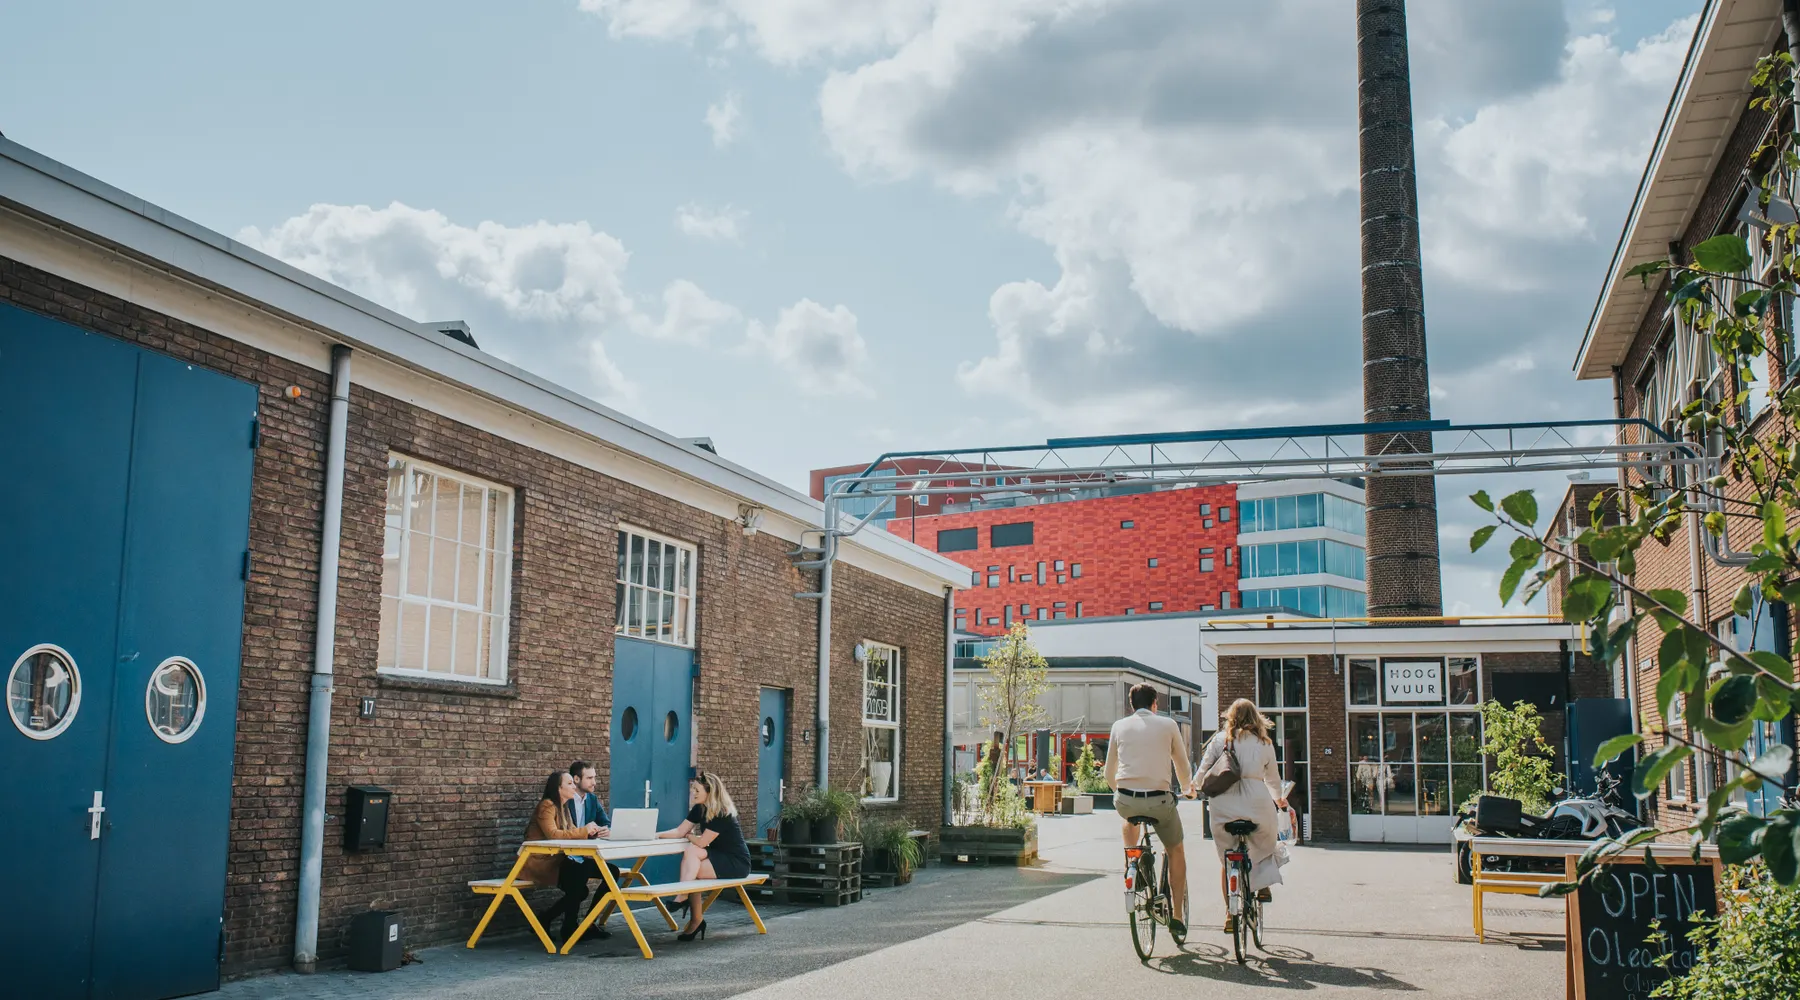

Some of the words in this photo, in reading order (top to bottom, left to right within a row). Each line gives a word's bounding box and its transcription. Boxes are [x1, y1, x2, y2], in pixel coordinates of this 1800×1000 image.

[1390, 669, 1436, 679] HOOG
[1391, 685, 1436, 694] VUUR
[363, 699, 375, 715] 17
[1600, 872, 1697, 922] OPEN
